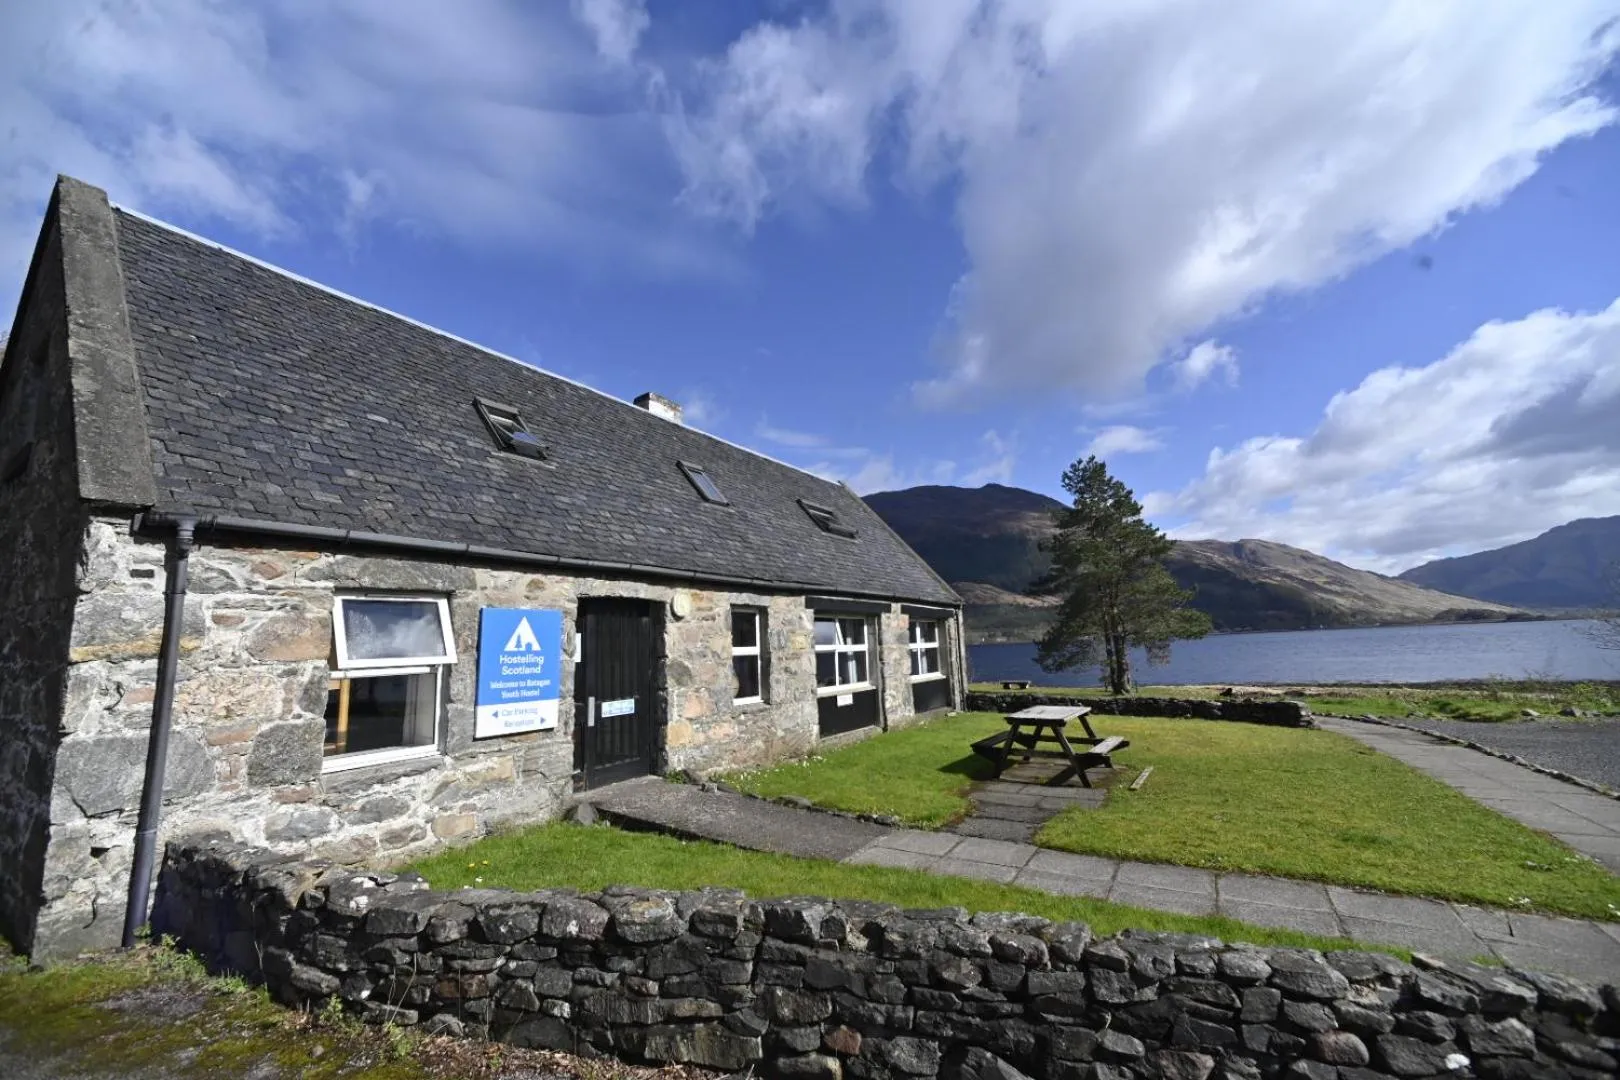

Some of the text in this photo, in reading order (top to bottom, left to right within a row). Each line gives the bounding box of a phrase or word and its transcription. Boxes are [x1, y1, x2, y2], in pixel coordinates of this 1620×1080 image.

[500, 654, 544, 665] Hostelling
[502, 665, 541, 675] Scotland
[490, 681, 518, 689] Welcome
[501, 688, 540, 699] Youth Hostel
